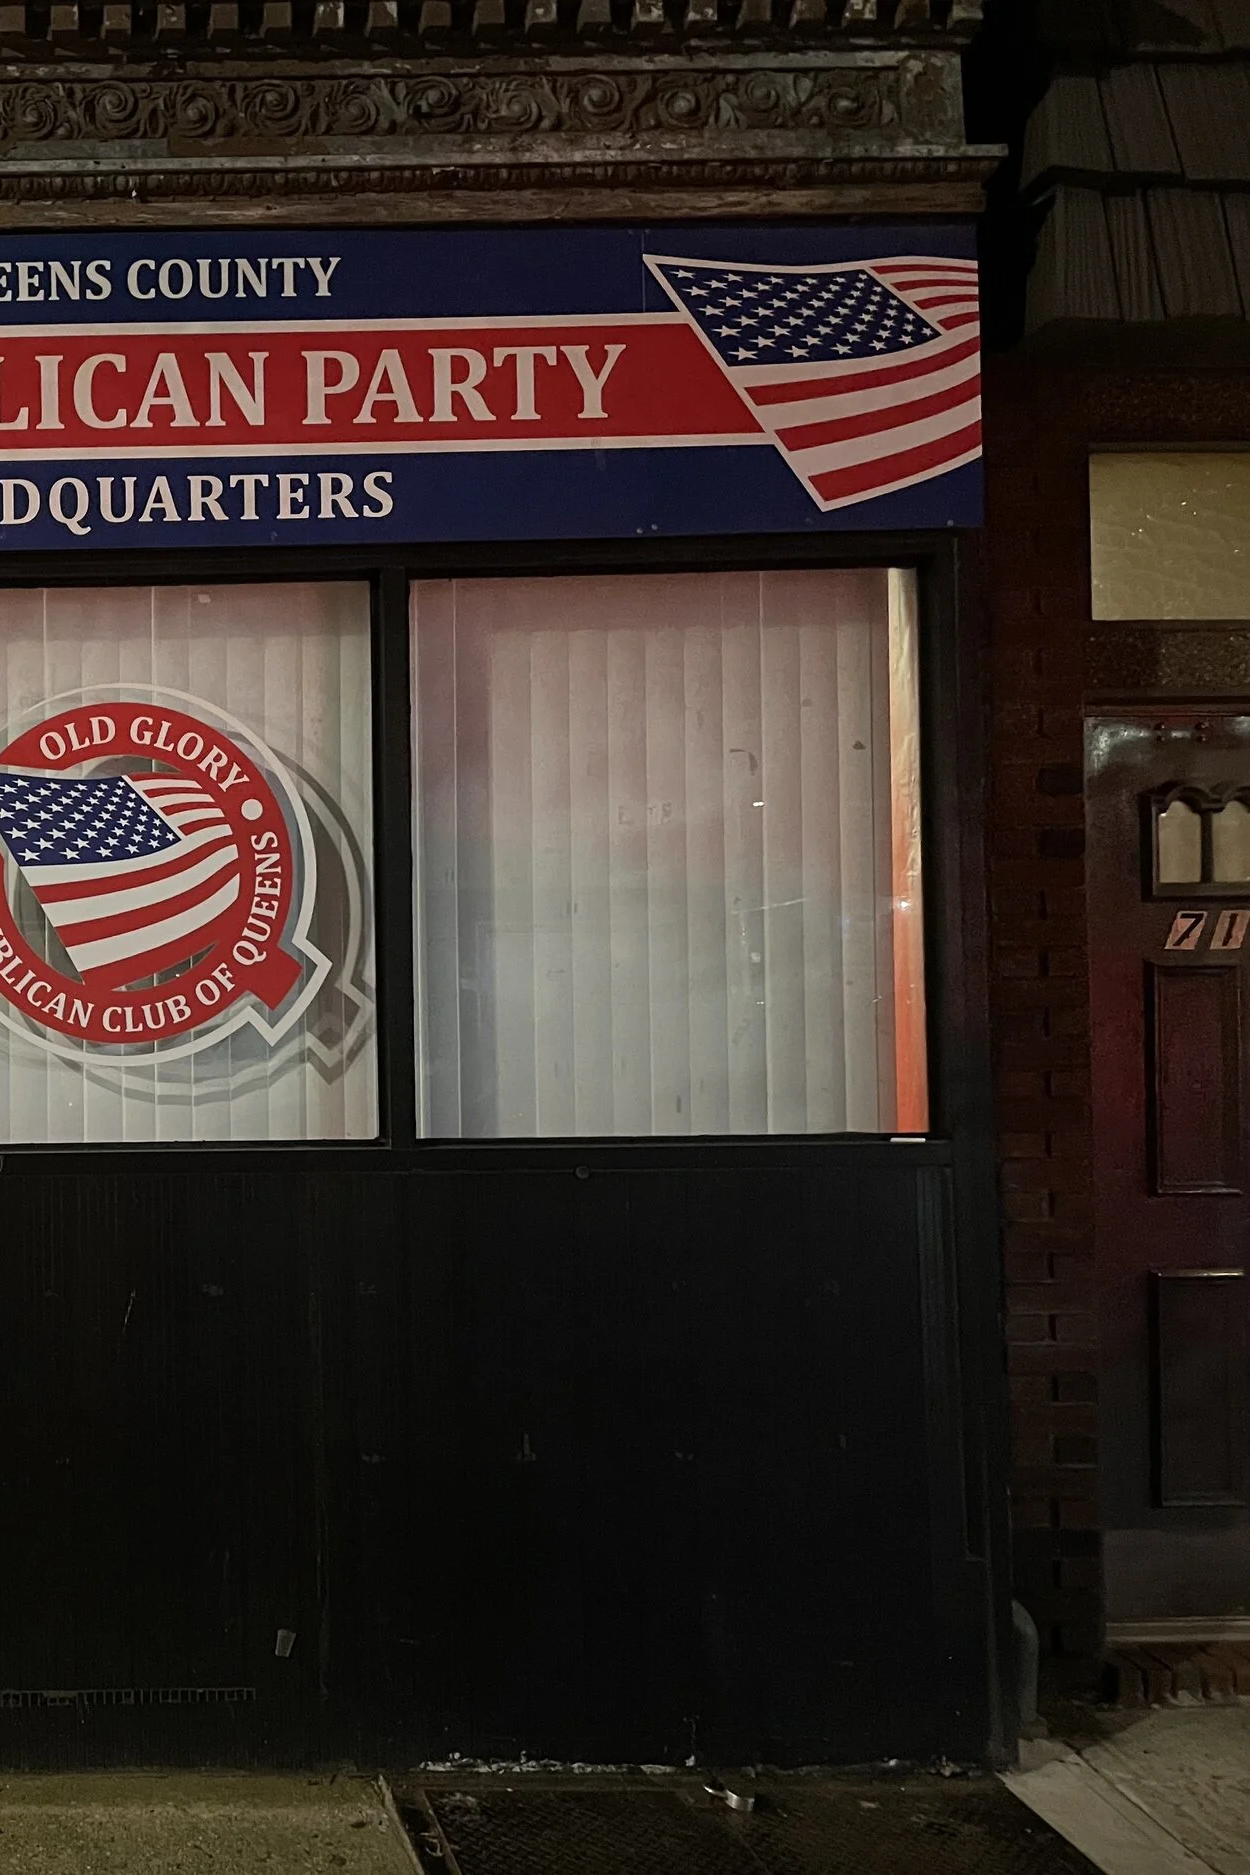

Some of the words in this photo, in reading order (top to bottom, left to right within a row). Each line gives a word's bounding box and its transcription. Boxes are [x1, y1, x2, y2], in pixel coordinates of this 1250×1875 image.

[127, 256, 342, 301] COUNTY
[301, 343, 627, 424] PARTY
[39, 715, 117, 762] OLD
[129, 715, 249, 793] GLORY
[101, 999, 192, 1033] CLUB
[195, 962, 237, 1008] OF
[232, 830, 282, 966] QUEENS
